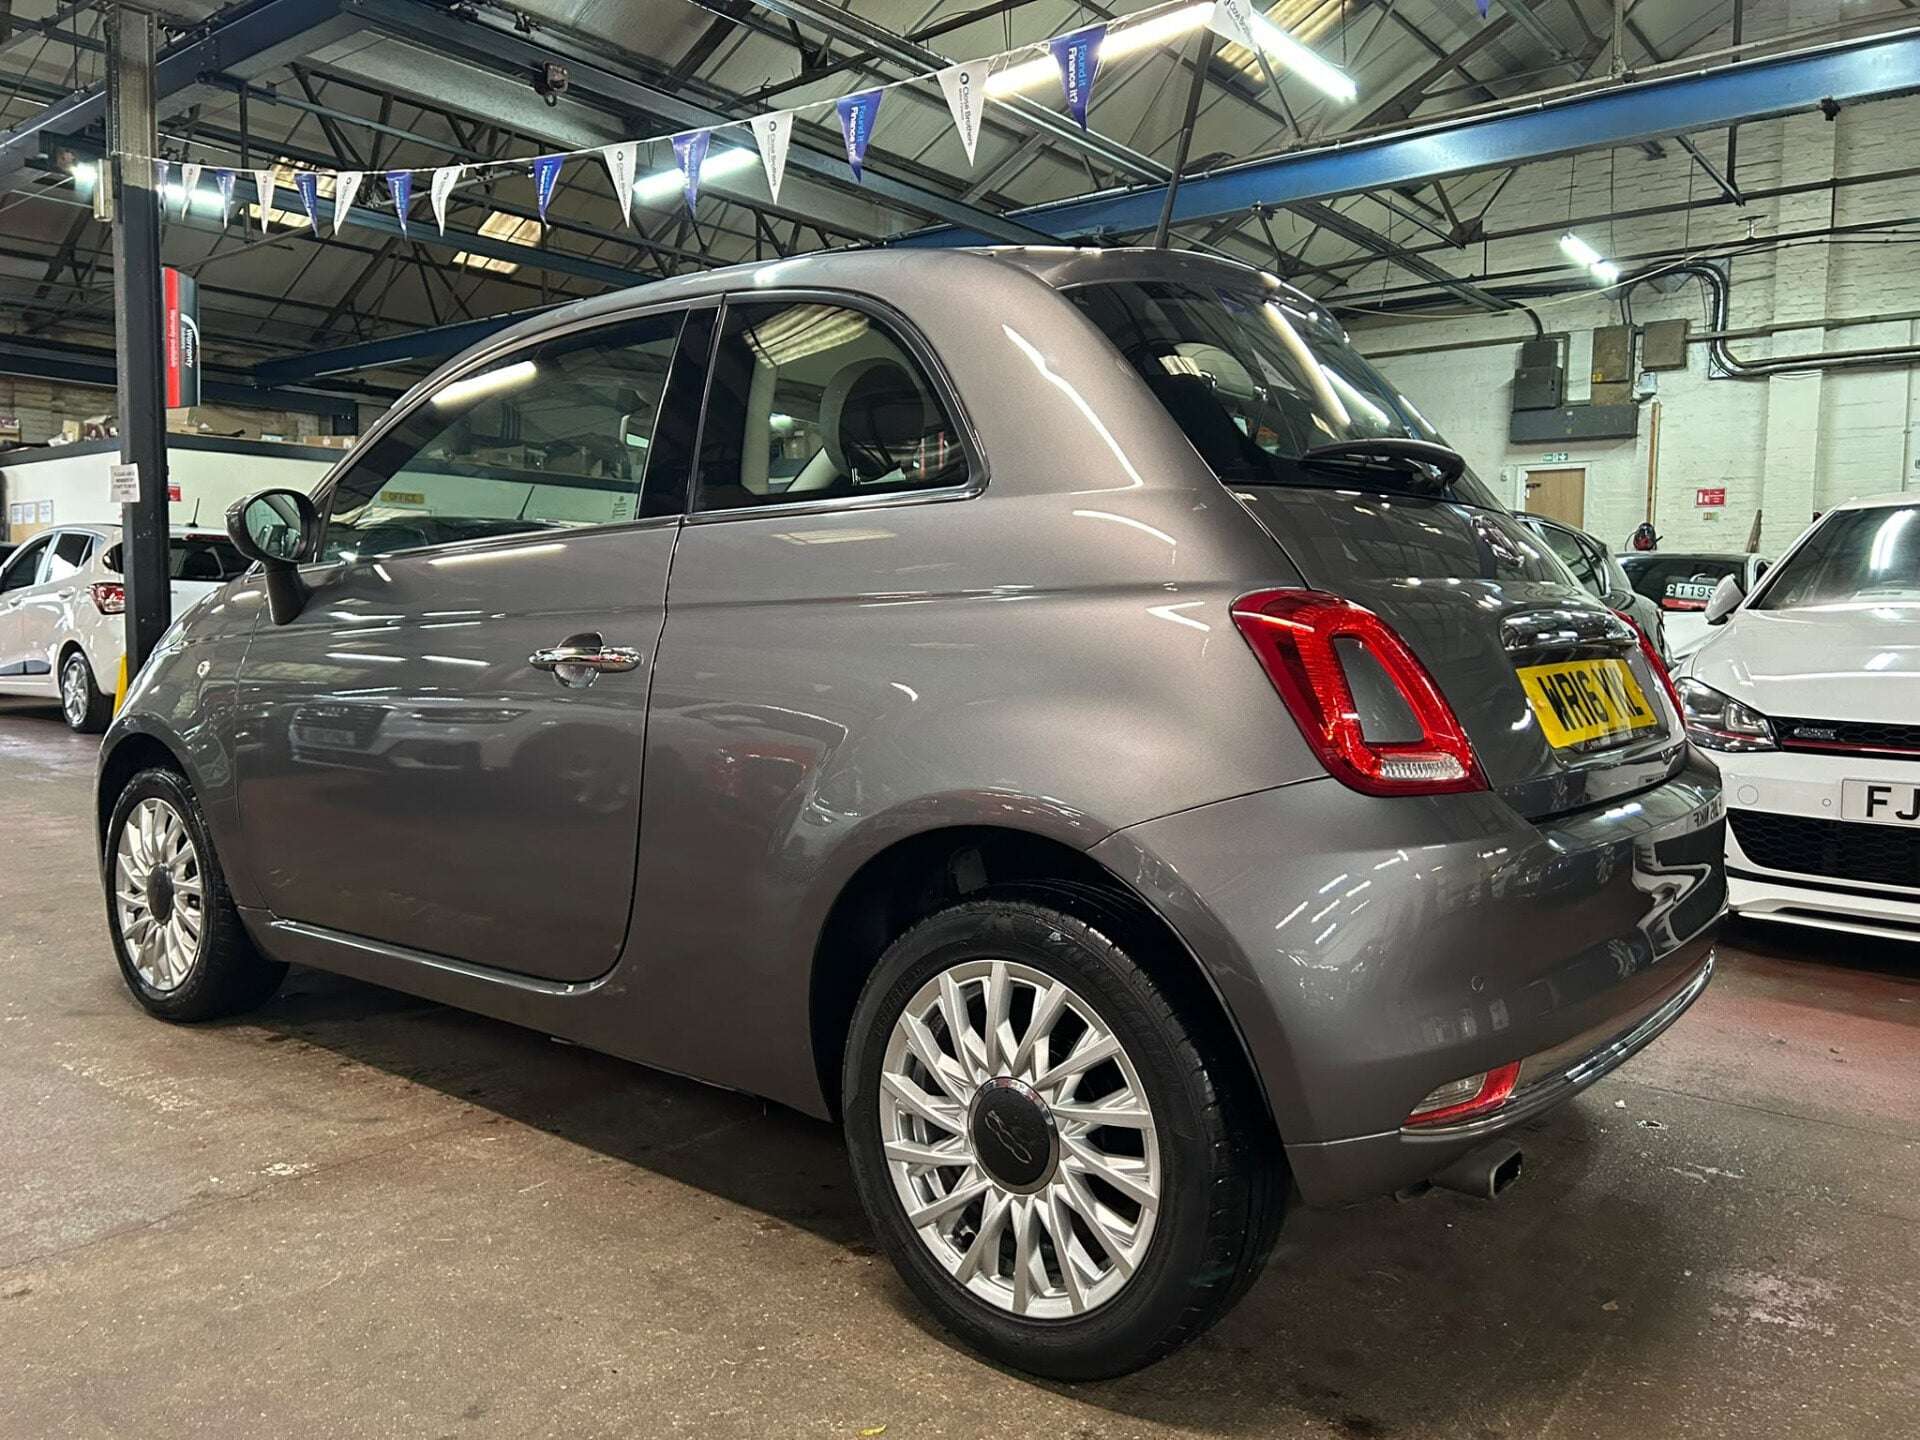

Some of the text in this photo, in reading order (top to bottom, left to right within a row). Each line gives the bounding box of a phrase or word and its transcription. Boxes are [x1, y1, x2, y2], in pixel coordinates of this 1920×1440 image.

[1068, 47, 1077, 88] Finance
[1078, 44, 1087, 76] Found
[849, 106, 858, 143] Finance
[858, 105, 866, 135] Found
[965, 110, 973, 147] Brothers
[185, 328, 193, 368] Warranty
[1536, 671, 1609, 732] WR16
[1866, 786, 1920, 820] FJ
